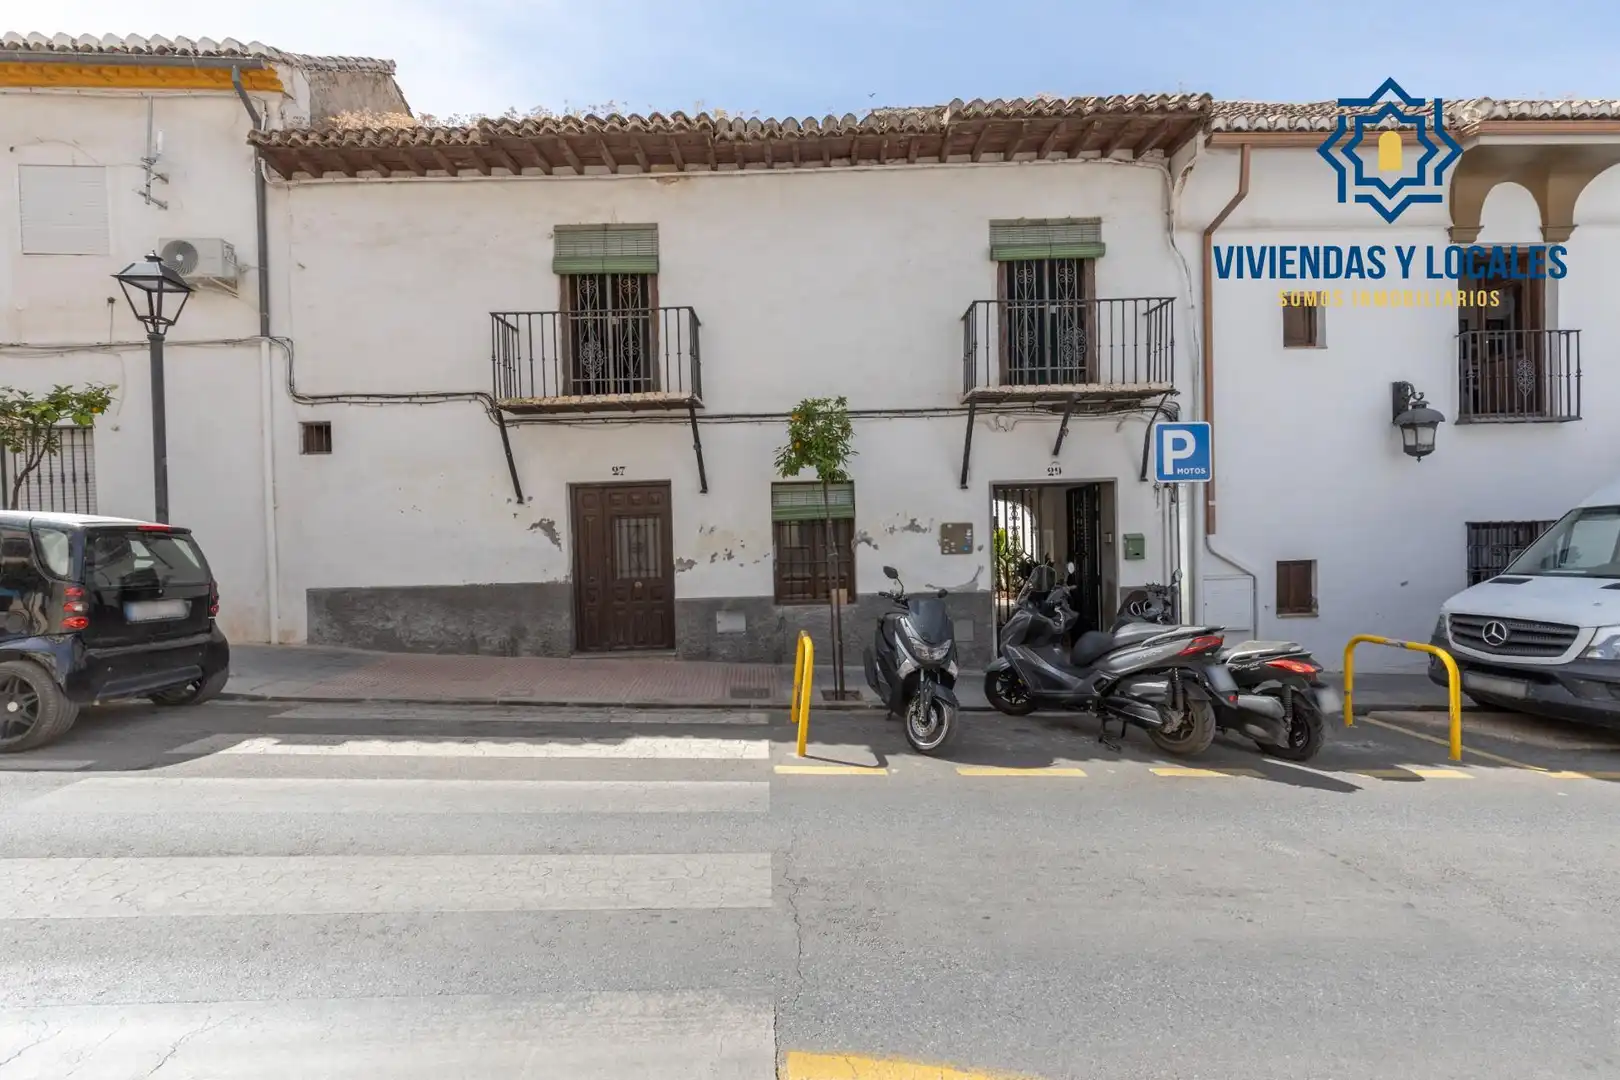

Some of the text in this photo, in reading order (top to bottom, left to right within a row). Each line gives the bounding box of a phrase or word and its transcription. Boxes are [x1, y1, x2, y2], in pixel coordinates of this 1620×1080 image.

[1163, 429, 1196, 475] P
[611, 465, 626, 476] 27
[1177, 467, 1206, 475] MOTOS
